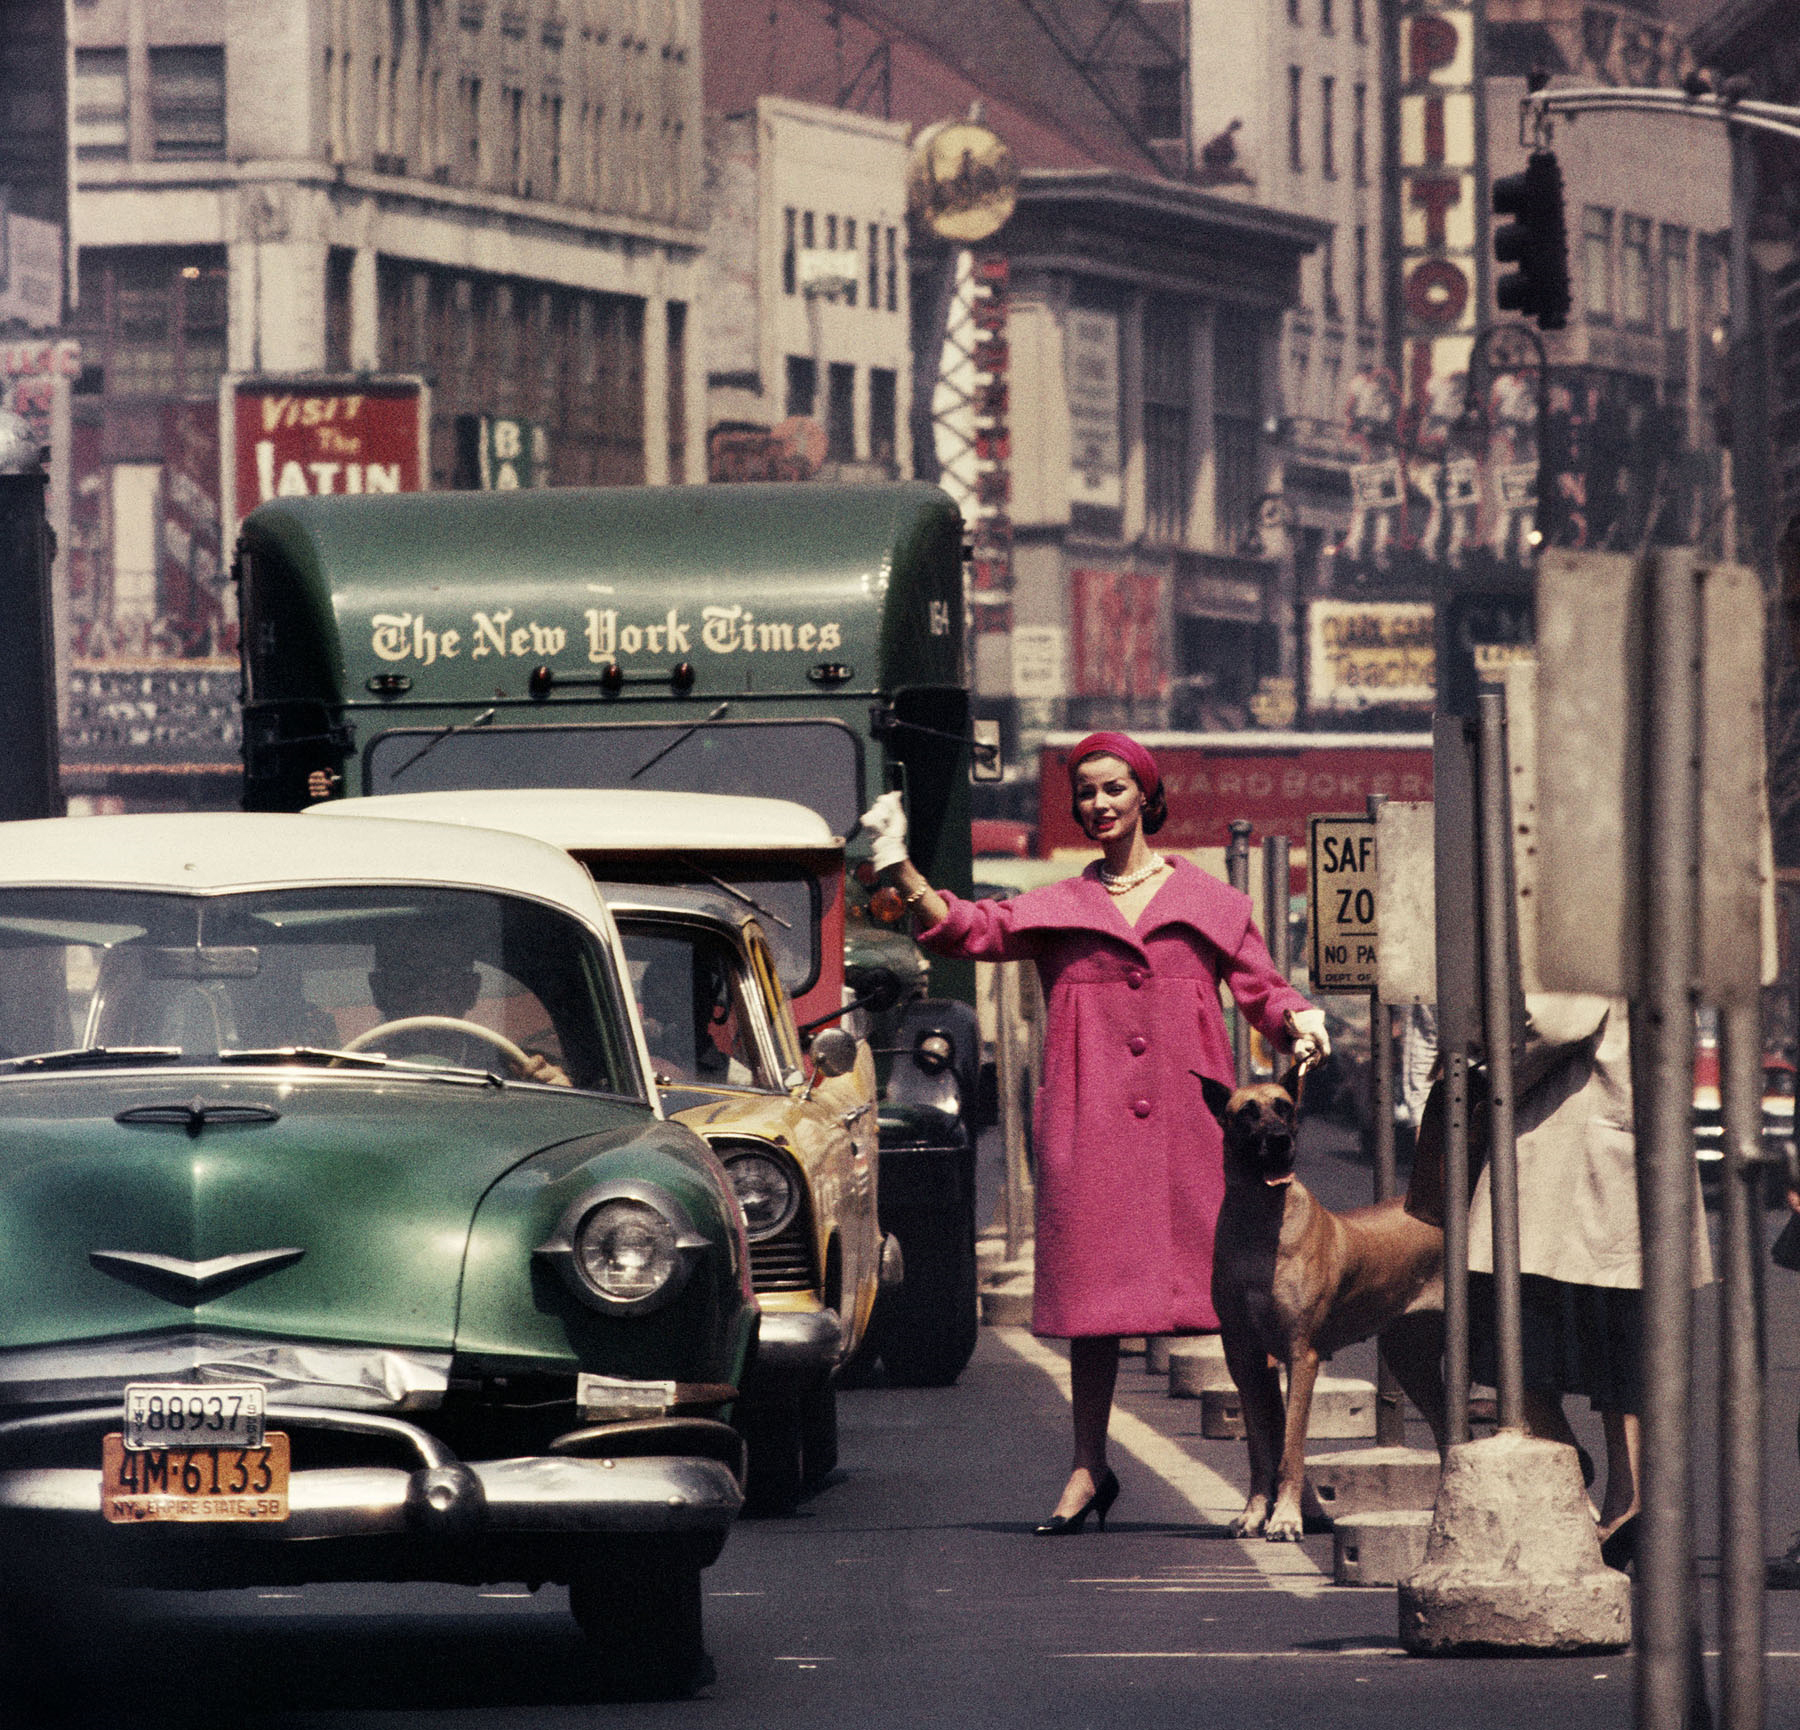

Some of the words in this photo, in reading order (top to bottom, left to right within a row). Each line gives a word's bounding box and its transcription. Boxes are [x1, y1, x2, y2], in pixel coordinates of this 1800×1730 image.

[260, 395, 365, 432] VISIT
[255, 440, 400, 501] LATIN
[494, 420, 521, 490] BA
[371, 612, 461, 666] The
[472, 608, 567, 661] New
[584, 608, 692, 665] York
[702, 605, 842, 654] Times
[1164, 771, 1273, 795] WARD
[1282, 769, 1434, 797] BOKER
[1323, 836, 1377, 873] SAF
[1336, 888, 1375, 925] ZO
[1325, 945, 1347, 964] NO
[1357, 945, 1377, 964] PA
[149, 1396, 243, 1431] 88937
[113, 1502, 135, 1516] NY
[148, 1500, 201, 1515] EMPIRE
[203, 1500, 246, 1515] STATE
[257, 1500, 280, 1515] 58
